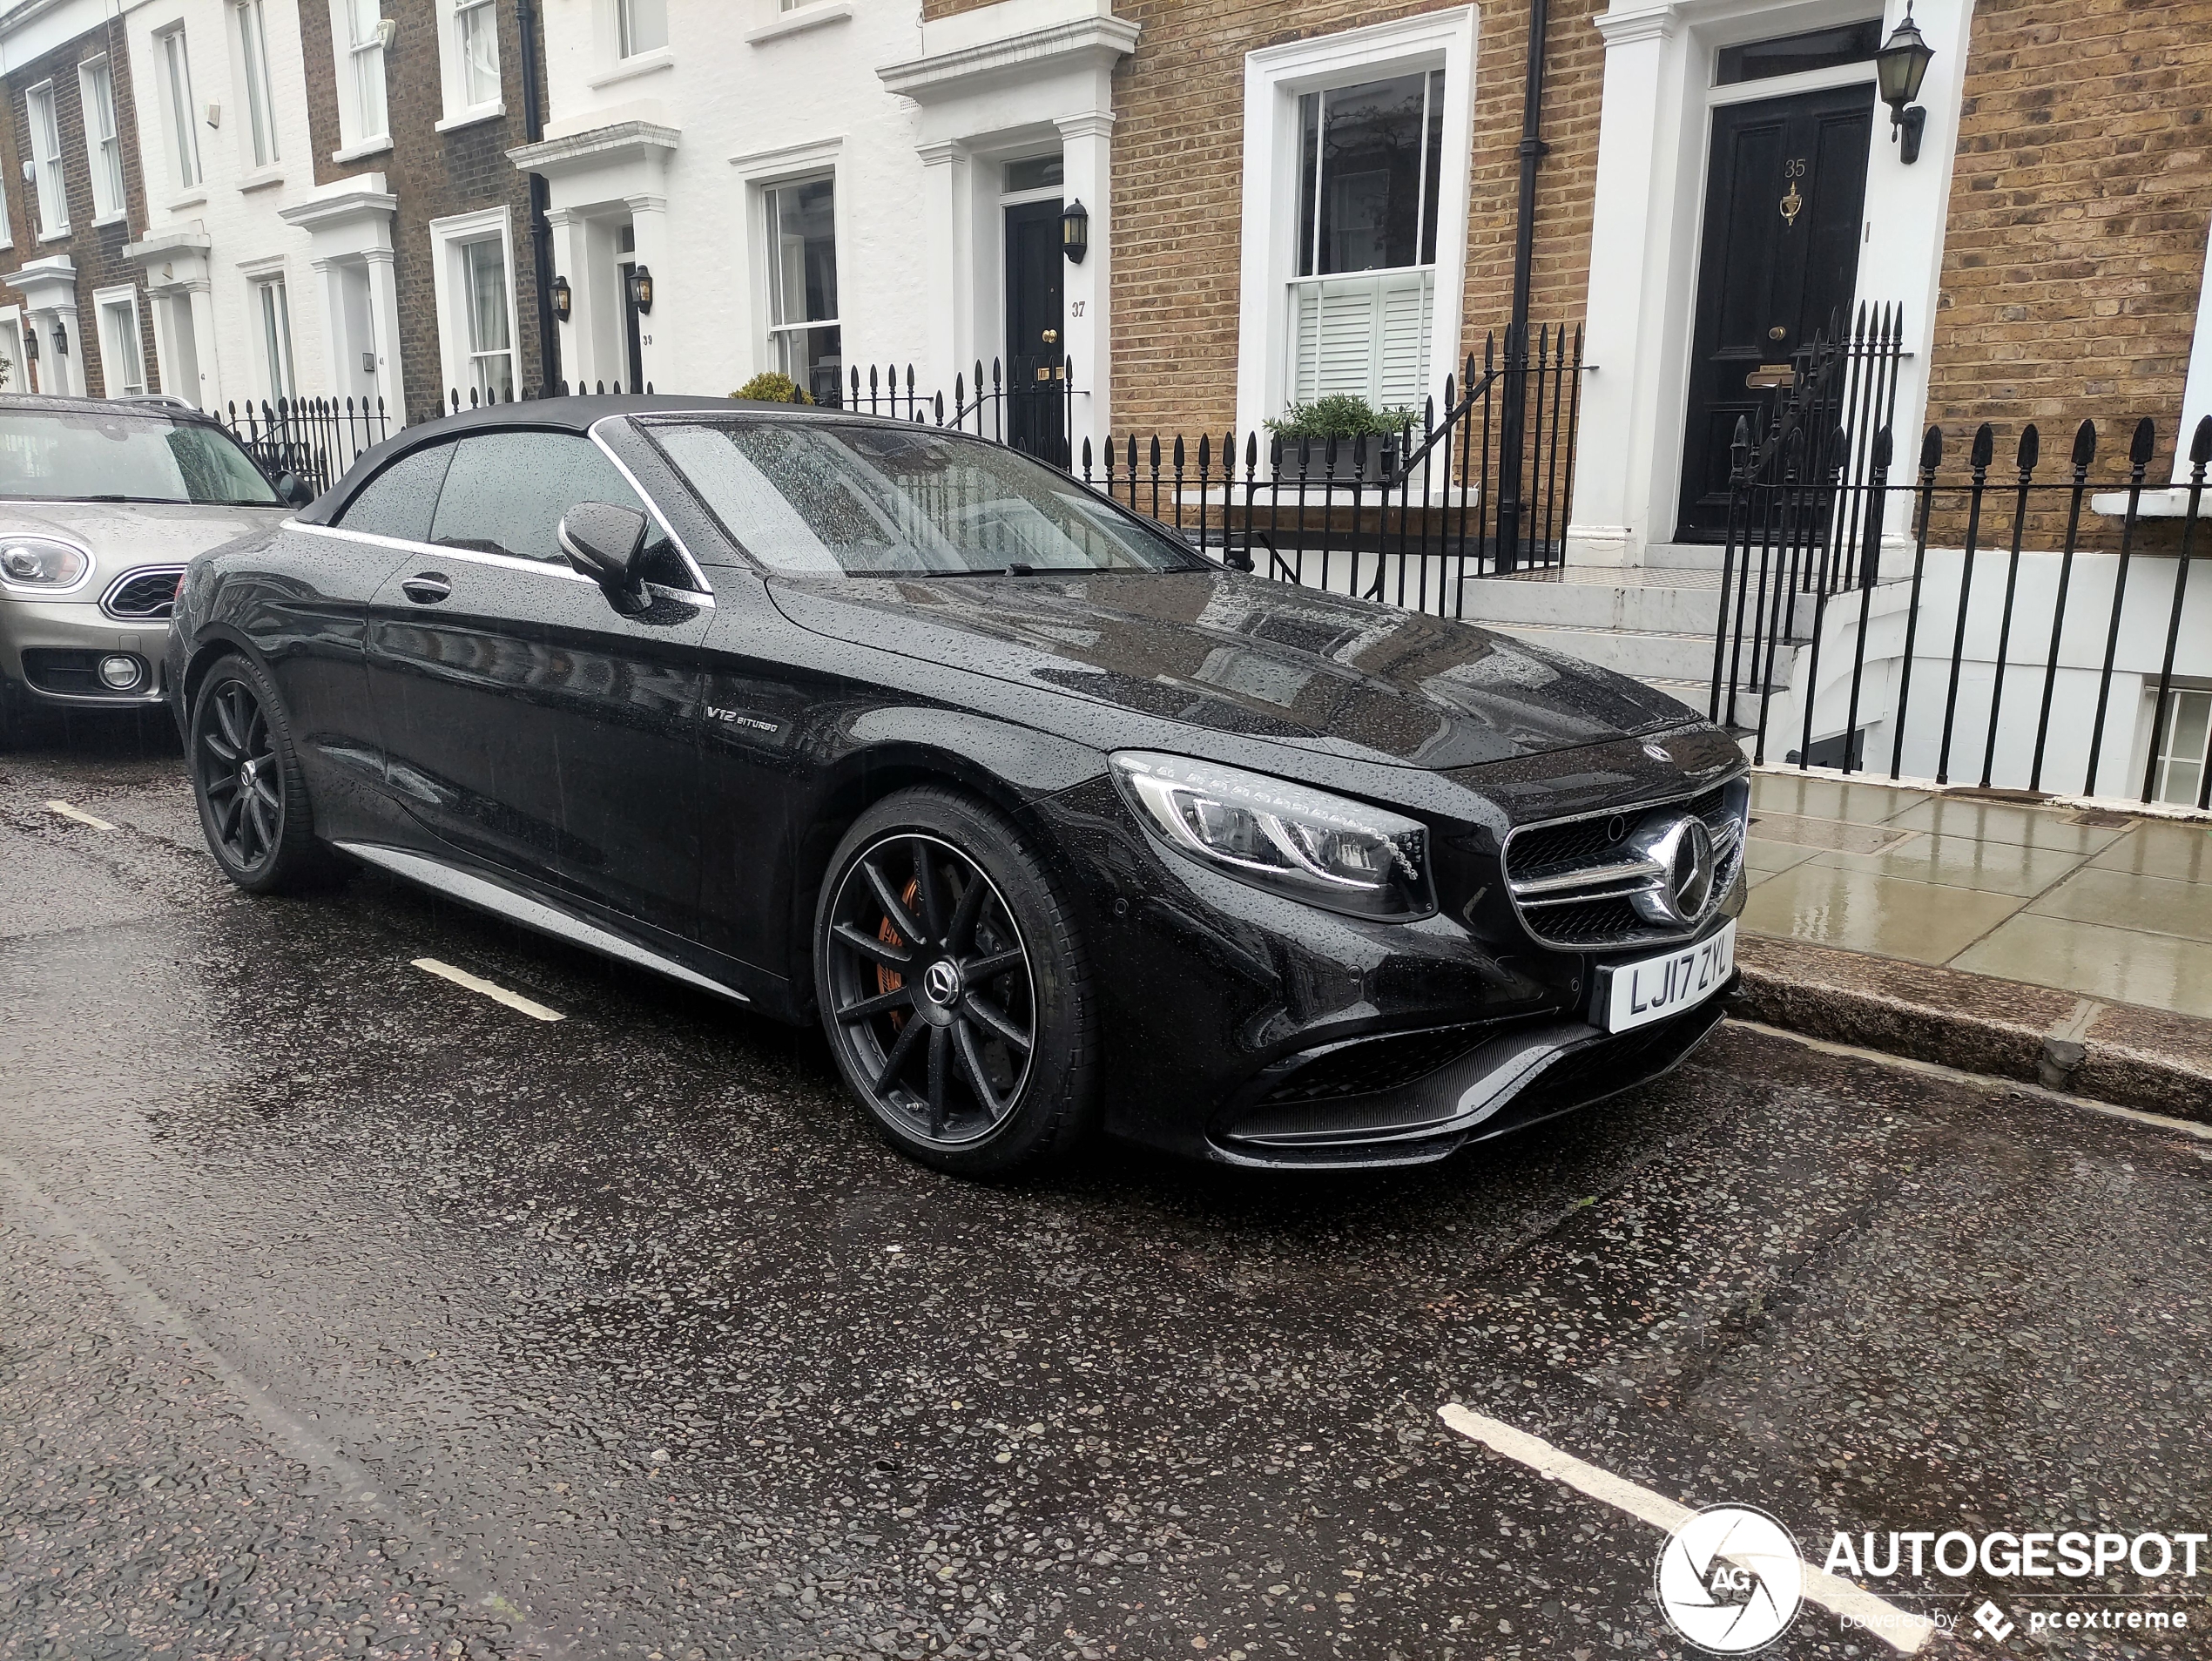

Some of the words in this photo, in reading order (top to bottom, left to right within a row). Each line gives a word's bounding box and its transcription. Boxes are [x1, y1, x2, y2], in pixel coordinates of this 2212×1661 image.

[1784, 159, 1806, 179] 35
[1071, 300, 1086, 318] 37
[643, 334, 652, 346] 39
[706, 706, 738, 722] V12
[737, 717, 779, 733] BITURBO
[1630, 953, 1696, 1016] LJ17
[1697, 934, 1727, 992] ZYL
